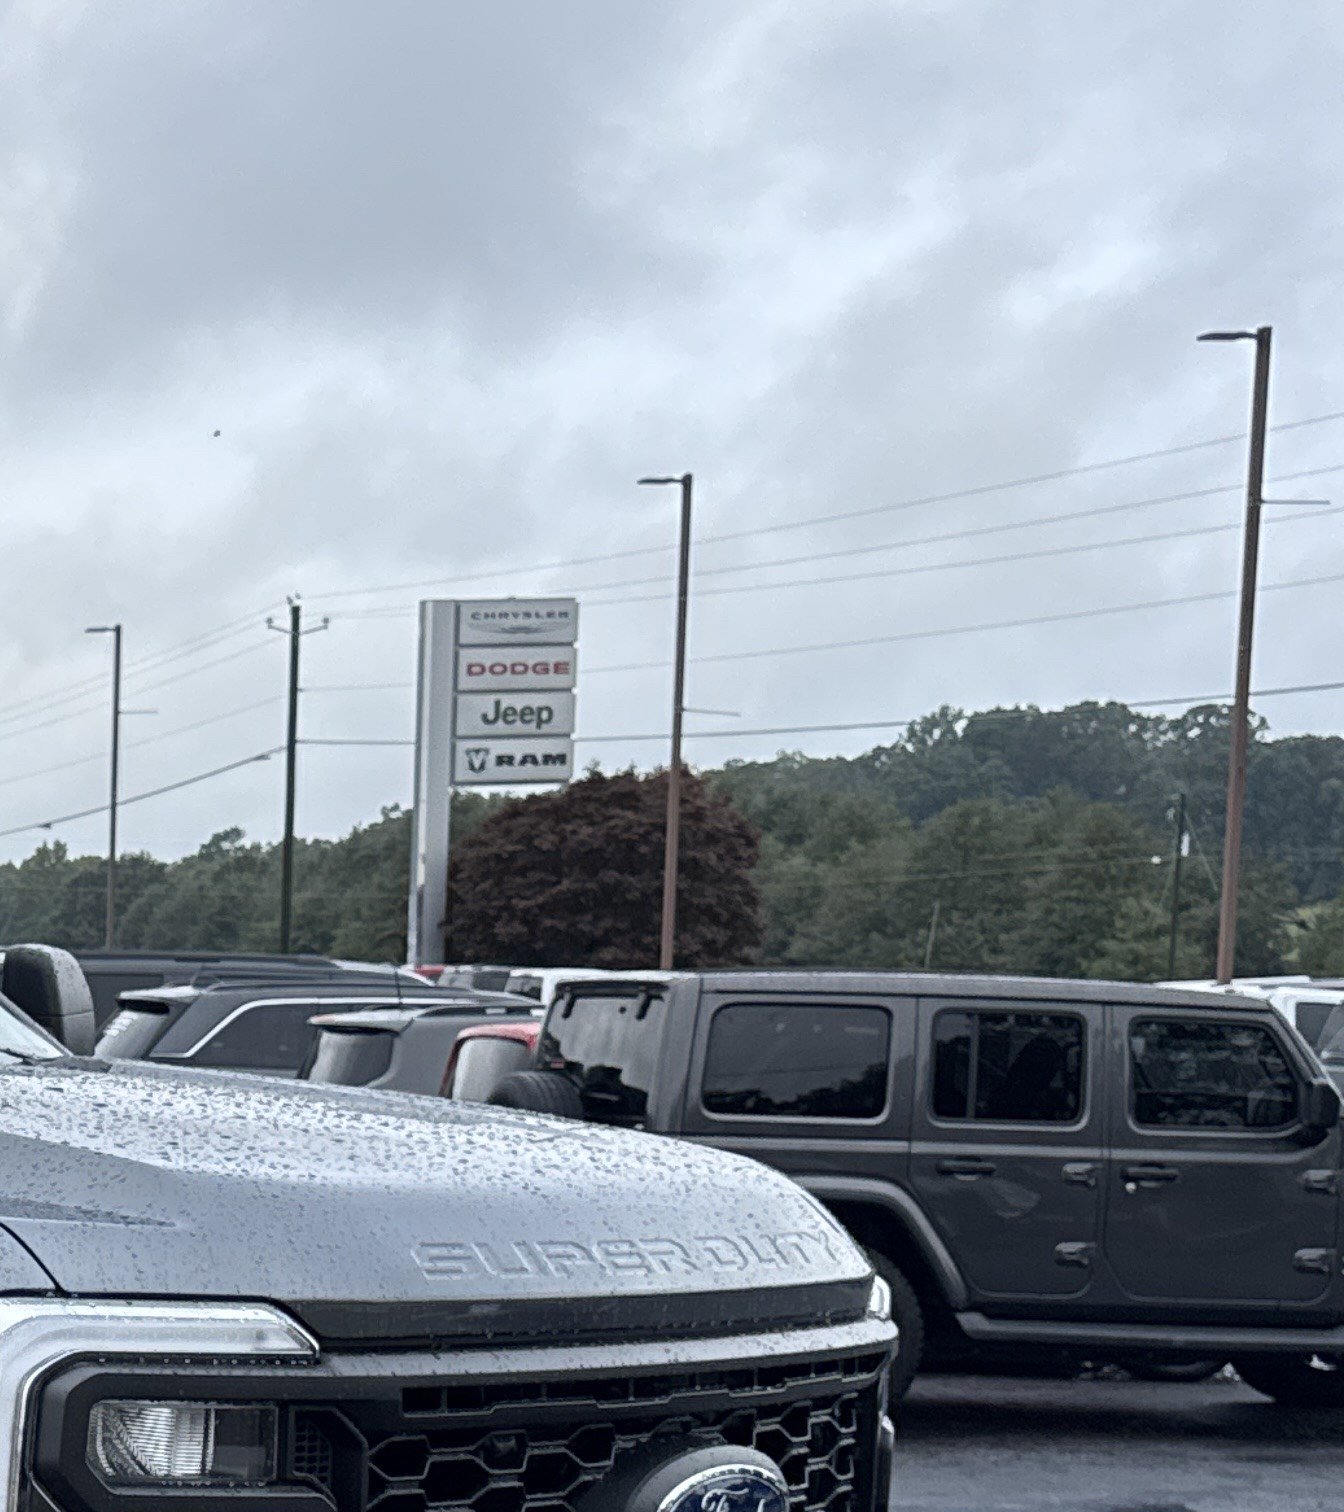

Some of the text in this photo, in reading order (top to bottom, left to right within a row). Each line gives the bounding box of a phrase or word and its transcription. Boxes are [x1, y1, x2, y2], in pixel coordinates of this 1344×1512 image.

[470, 610, 569, 621] CHRYSLER
[466, 661, 570, 677] DODGE
[480, 699, 554, 729] Jeep
[494, 753, 568, 768] RAM
[411, 1229, 841, 1281] SUPER DUTY
